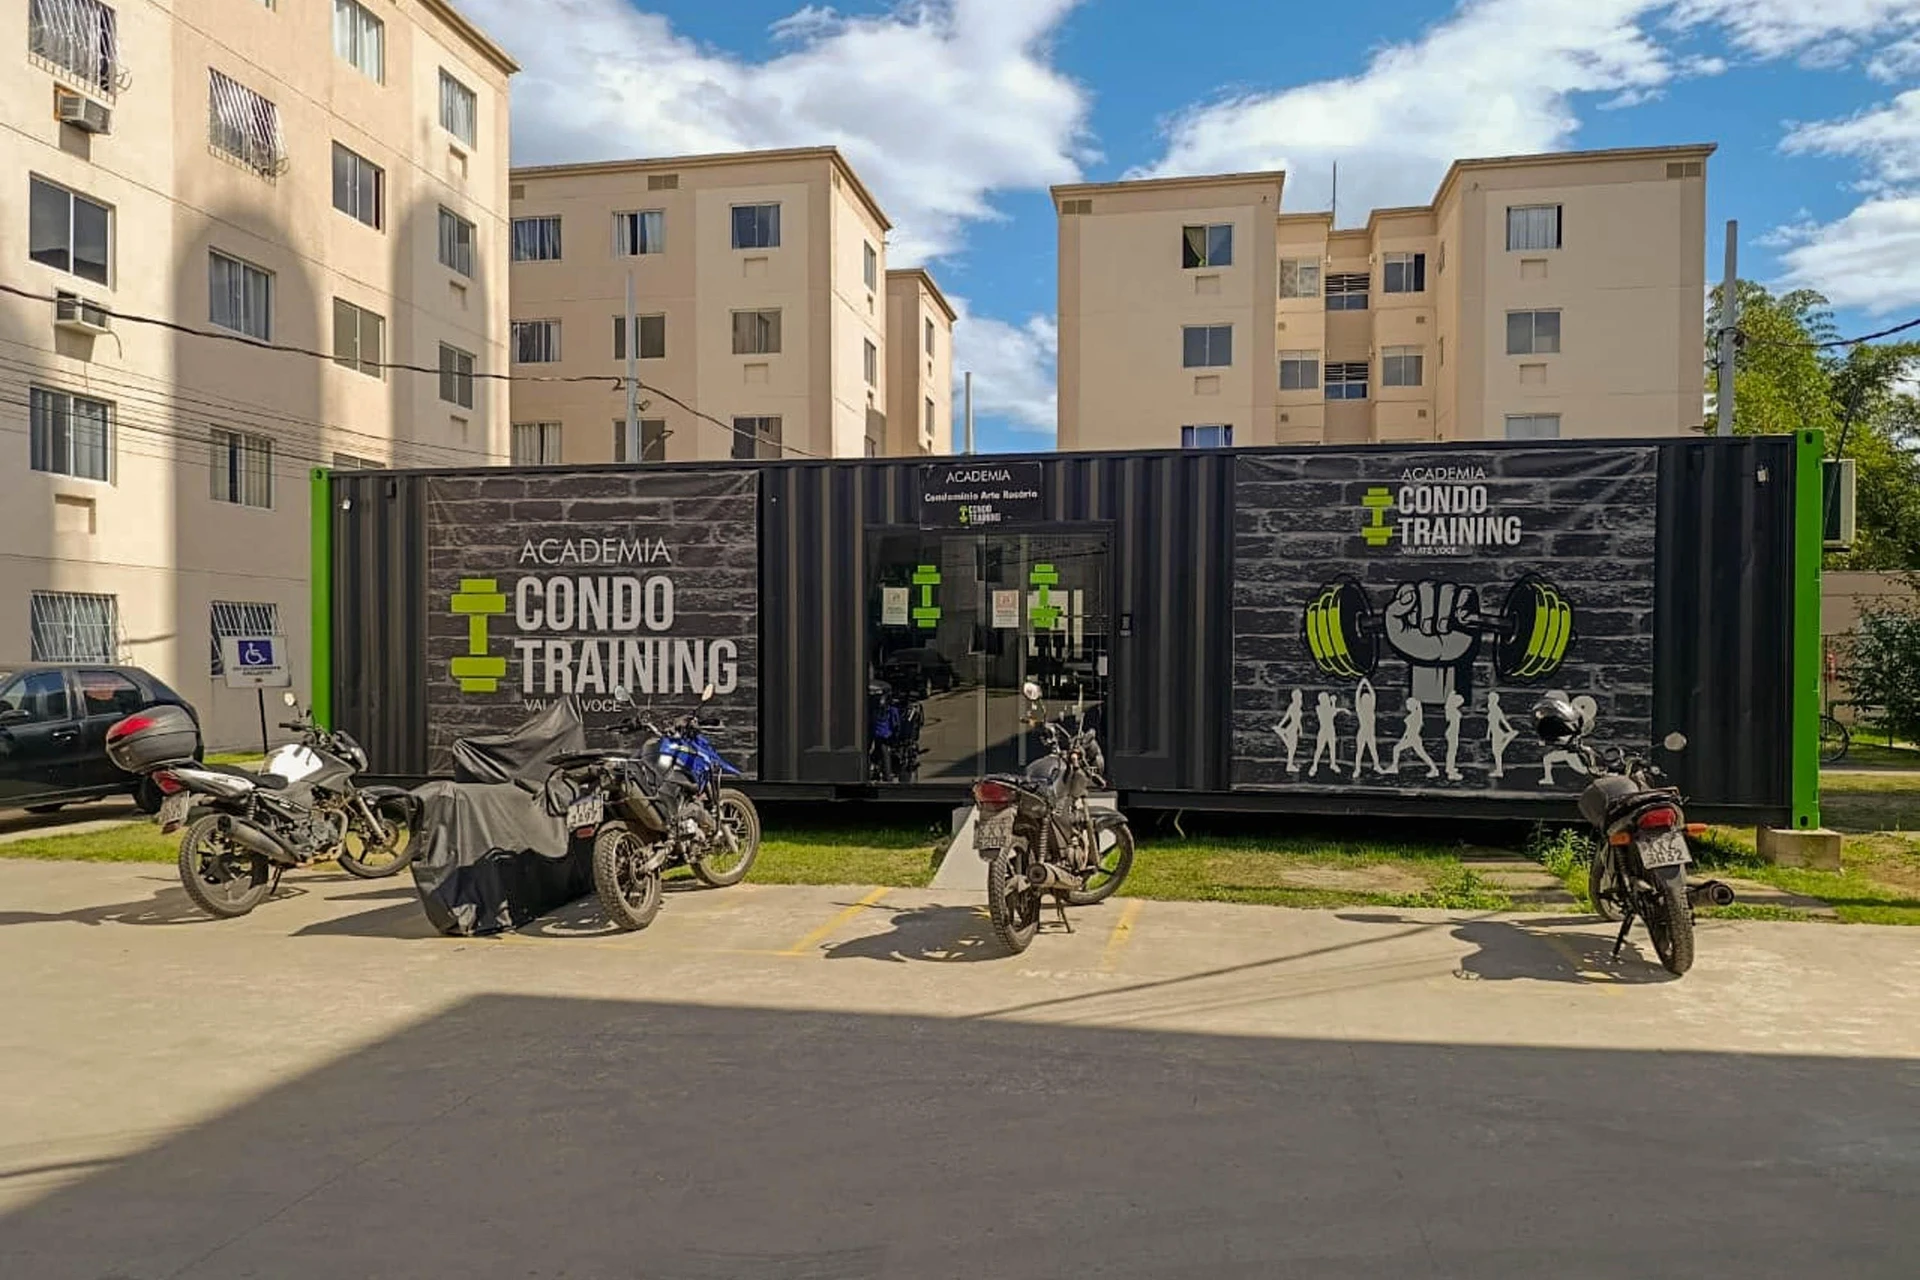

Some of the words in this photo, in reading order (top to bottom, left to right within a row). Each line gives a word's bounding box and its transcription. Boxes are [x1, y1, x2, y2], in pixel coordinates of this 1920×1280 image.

[945, 469, 1011, 484] ACADEMIA
[1401, 466, 1487, 482] ACADEMIA
[1399, 485, 1487, 515] CONDO
[1398, 516, 1522, 546] TRAINING
[519, 537, 672, 565] ACADEMIA
[515, 576, 675, 632] CONDO
[514, 638, 738, 695] TRAINING
